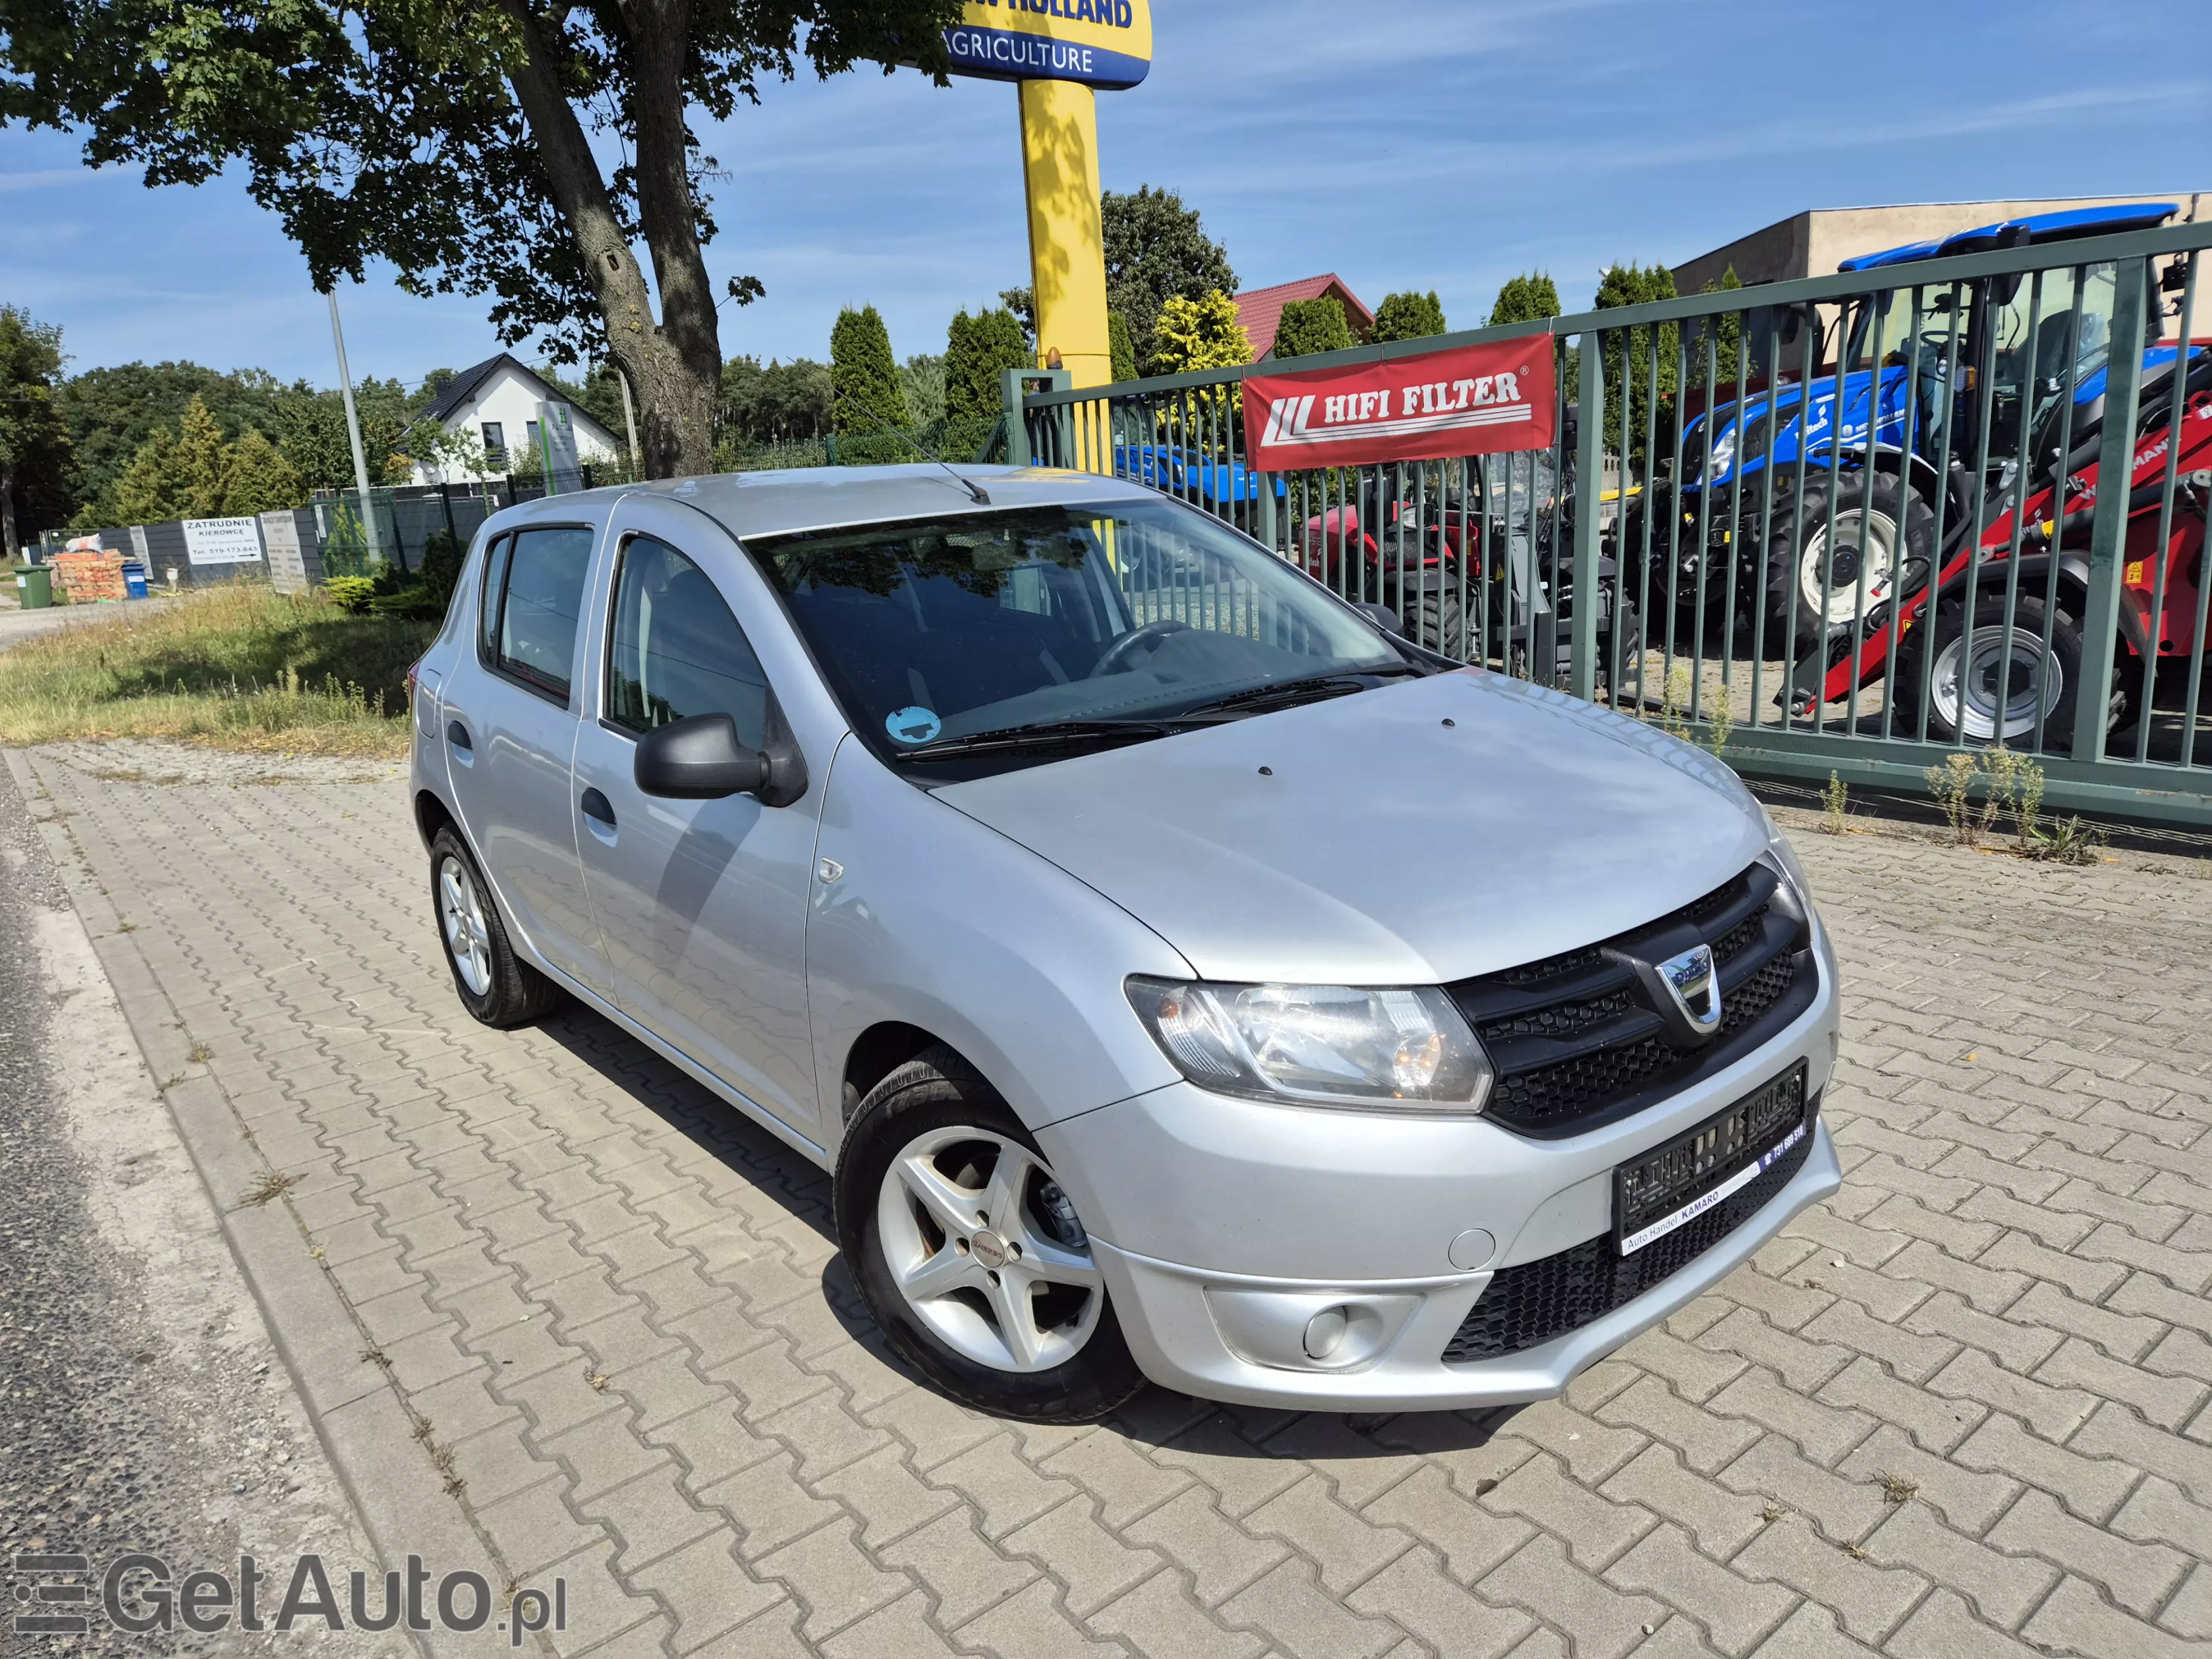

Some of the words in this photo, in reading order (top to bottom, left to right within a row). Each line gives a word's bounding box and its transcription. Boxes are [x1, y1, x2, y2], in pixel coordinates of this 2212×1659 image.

[1324, 390, 1389, 423] HIFI
[1402, 372, 1521, 416] FILTER
[187, 519, 252, 529] ZATRUDNIĘ
[1628, 1234, 1647, 1250] Auto
[1649, 1216, 1678, 1237] Handel
[1682, 1191, 1719, 1220] KAMARO
[1773, 1144, 1784, 1158] 731
[1794, 1125, 1803, 1141] 518
